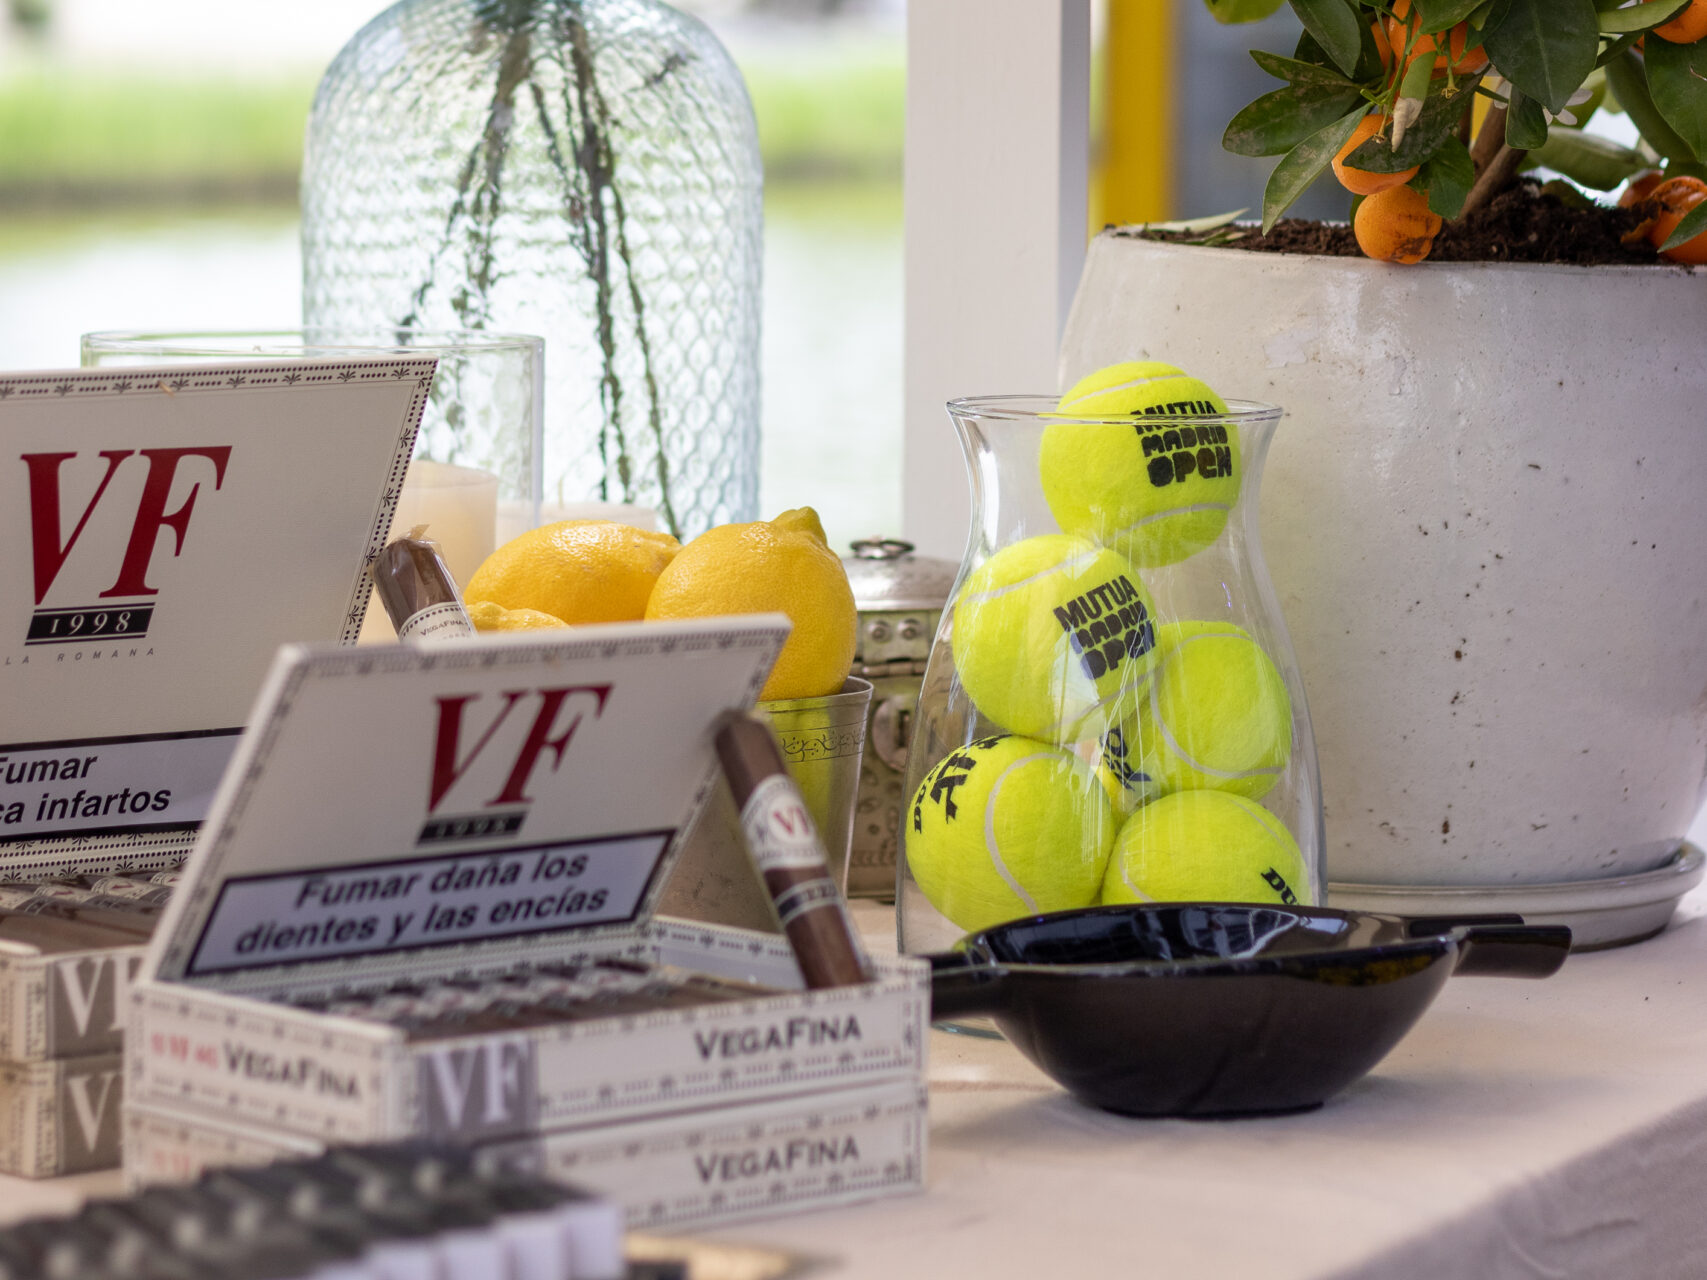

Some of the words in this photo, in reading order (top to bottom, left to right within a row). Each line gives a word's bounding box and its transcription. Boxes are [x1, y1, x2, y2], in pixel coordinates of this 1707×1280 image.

[1147, 445, 1232, 487] OPEN
[20, 445, 232, 605] VF
[50, 611, 131, 636] 1998
[1053, 574, 1138, 632] MUTUA
[1070, 600, 1147, 654] MADRID
[5, 656, 30, 665] LA
[57, 647, 154, 662] ROMANA
[1080, 620, 1155, 680] OPEN
[427, 682, 614, 816] VF
[36, 787, 171, 821] infartos
[294, 873, 422, 910] Fumar
[429, 855, 523, 894] daña
[531, 851, 589, 883] los
[1261, 866, 1298, 905] DU
[235, 916, 378, 955] dientes
[386, 911, 415, 945] y
[423, 902, 479, 934] las
[489, 884, 609, 925] encías
[428, 1037, 530, 1131] VF
